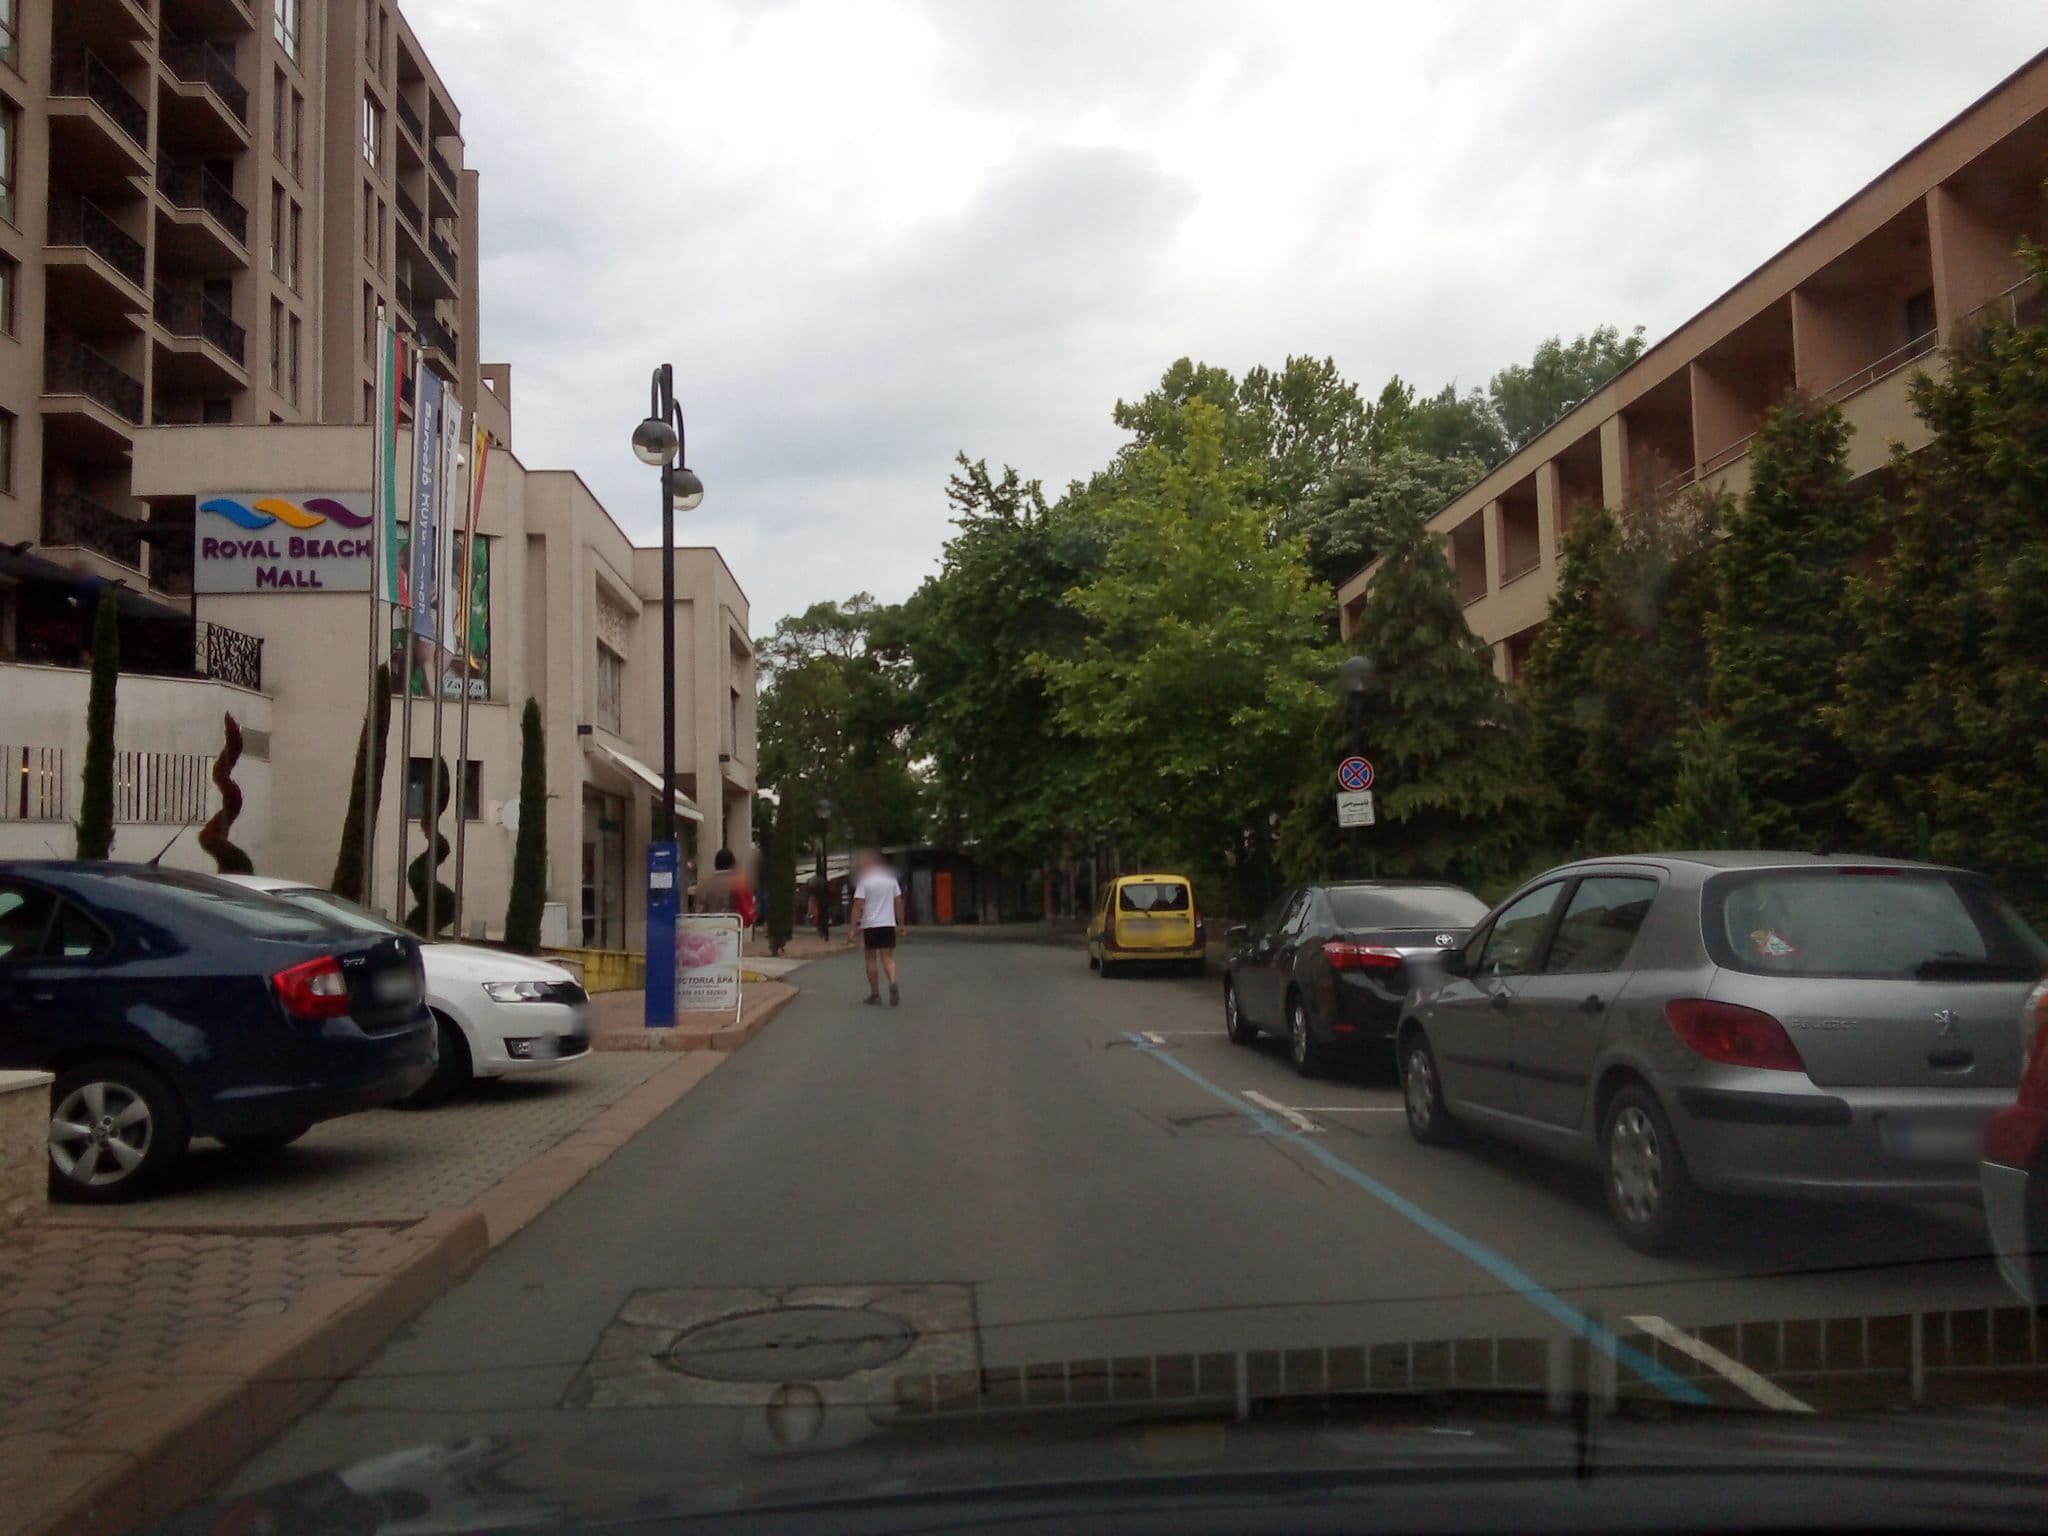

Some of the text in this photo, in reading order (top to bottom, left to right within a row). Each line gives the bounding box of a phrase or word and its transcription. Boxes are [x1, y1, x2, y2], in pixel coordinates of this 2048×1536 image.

[202, 536, 372, 559] ROYAL BEACH
[256, 566, 323, 588] MALL
